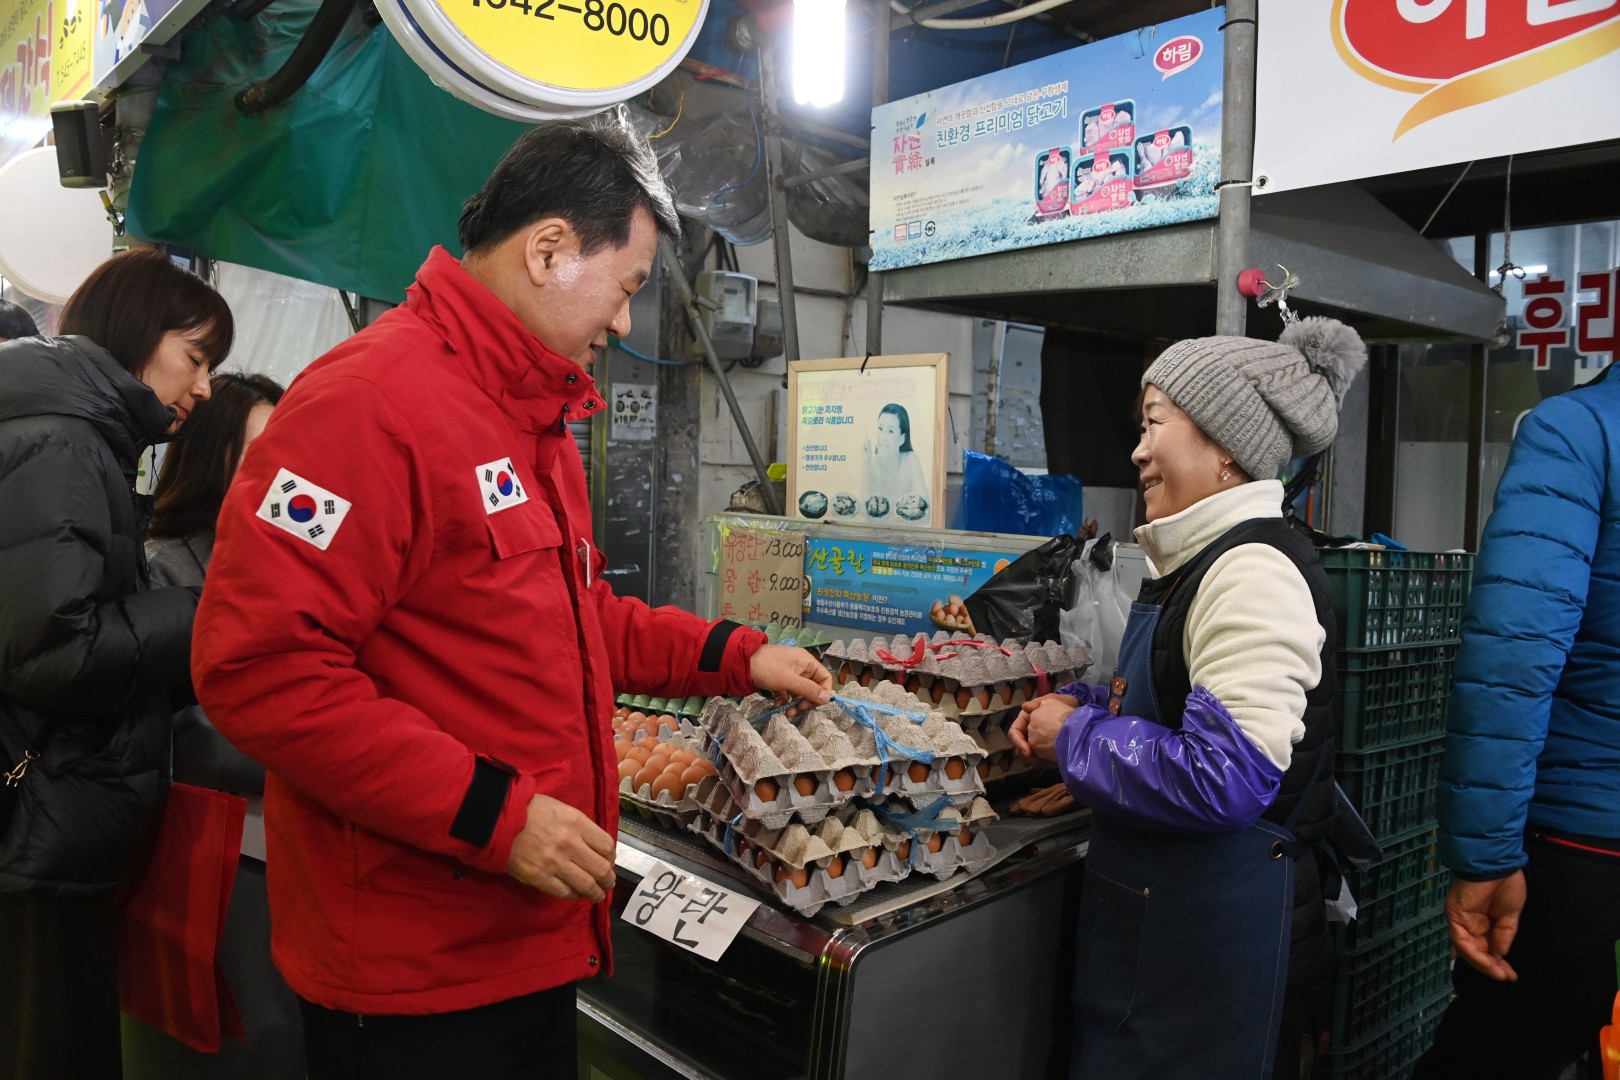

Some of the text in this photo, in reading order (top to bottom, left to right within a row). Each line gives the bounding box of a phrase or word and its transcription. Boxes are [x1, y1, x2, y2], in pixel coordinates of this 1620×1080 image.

[473, 0, 670, 46] 42-8000
[1163, 43, 1191, 63] 하림
[954, 107, 978, 120] 깨끗함과
[1025, 89, 1039, 100] 담은
[1041, 80, 1068, 98] 무항생제
[936, 124, 970, 148] 친환경
[974, 110, 1022, 137] 프리미엄
[1027, 97, 1067, 126] 닭고기
[892, 130, 921, 154] 자연
[802, 406, 824, 414] 닭고기는
[809, 546, 866, 575] 산골란
[872, 595, 887, 604] 이란?
[635, 871, 728, 949] 왕란
